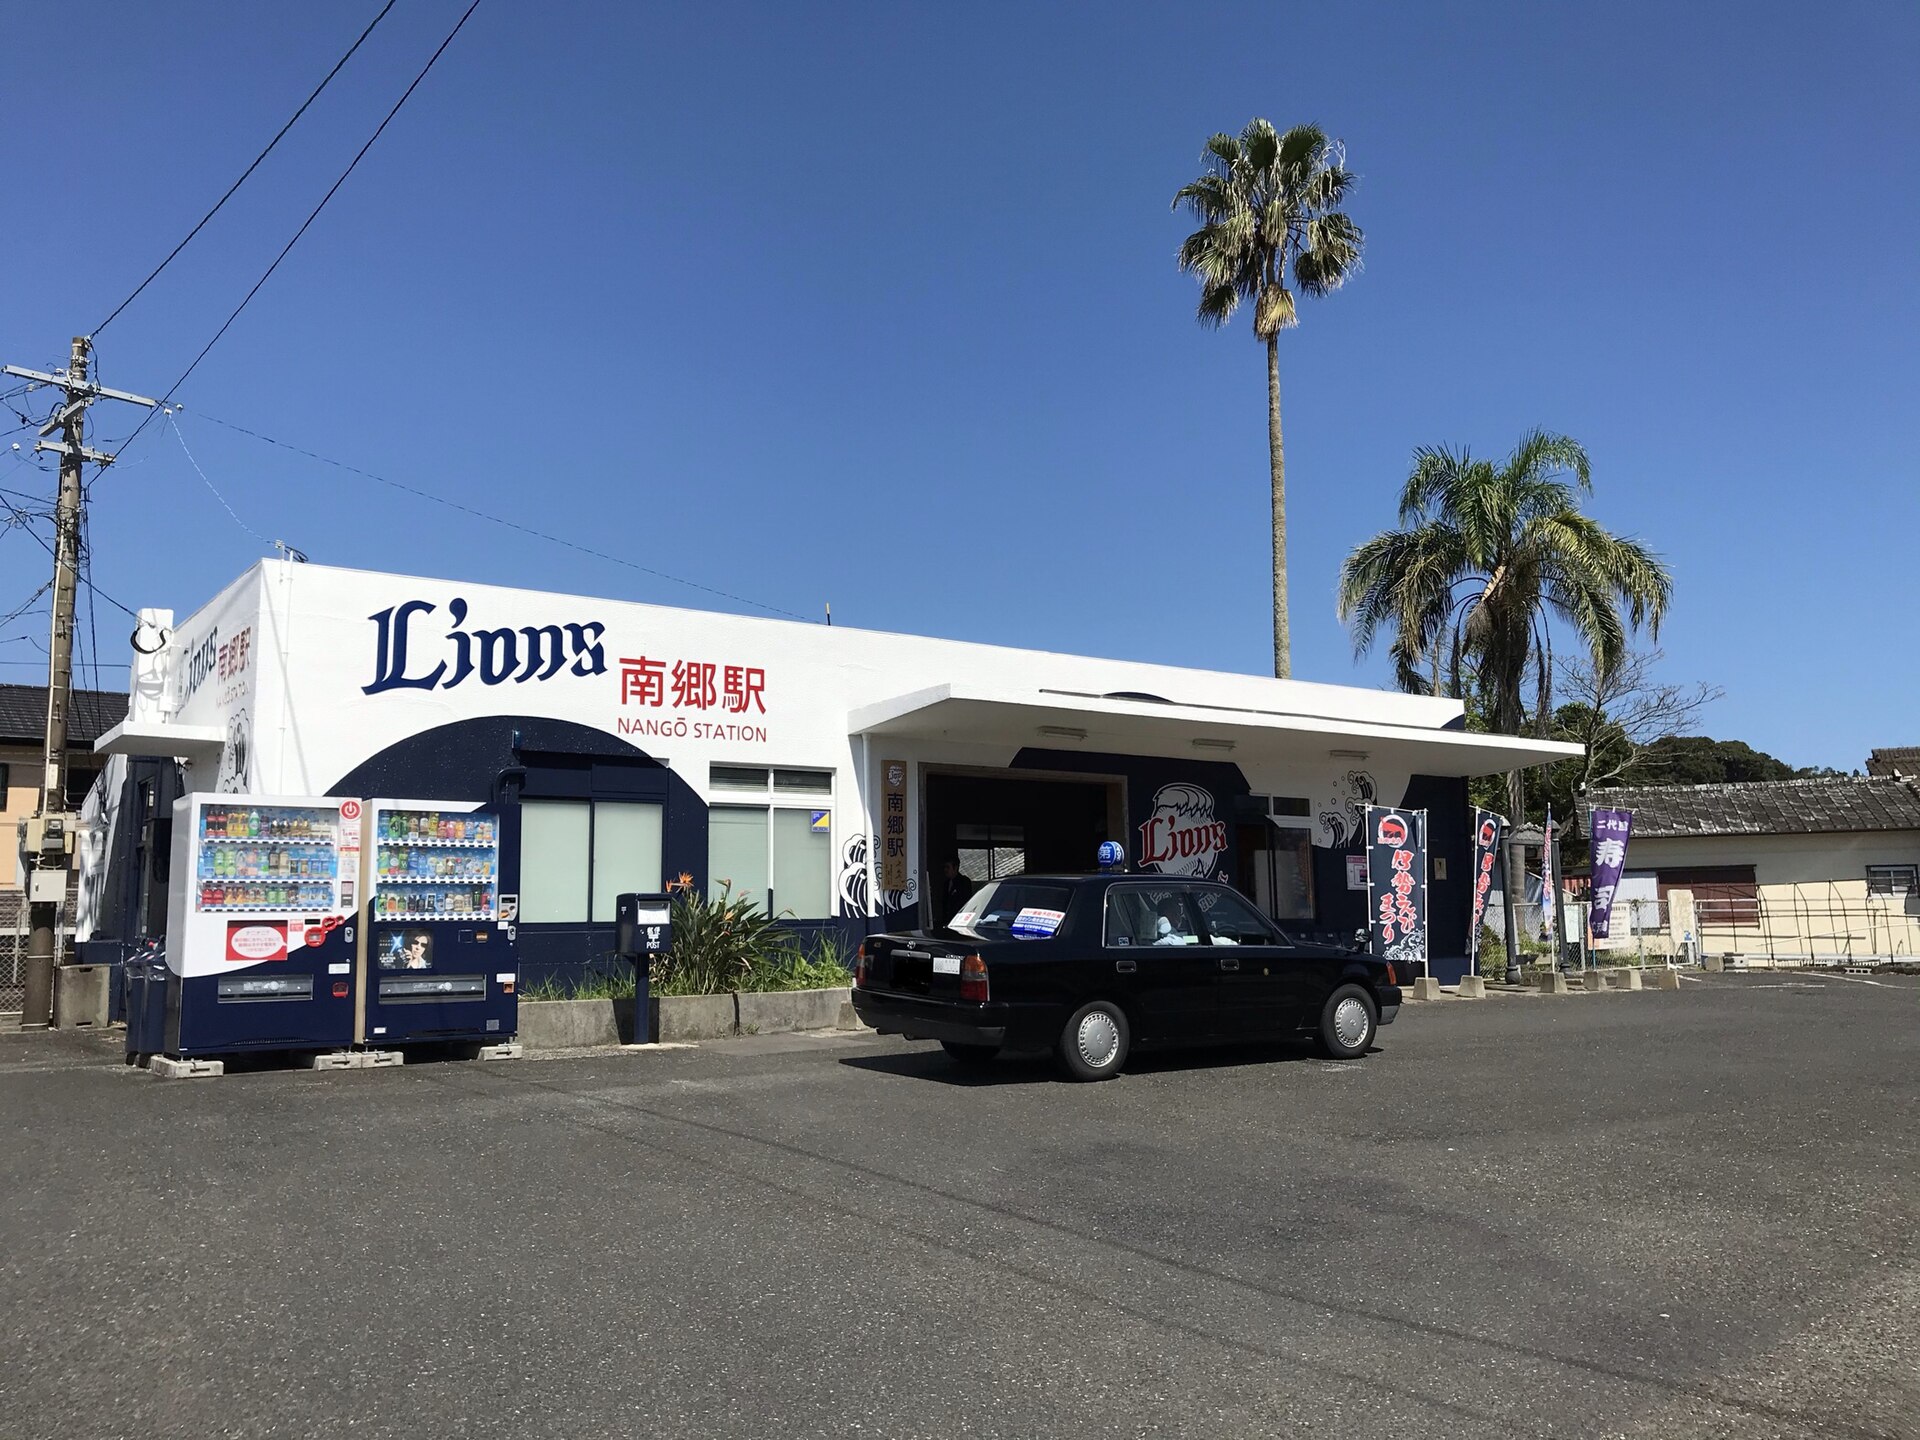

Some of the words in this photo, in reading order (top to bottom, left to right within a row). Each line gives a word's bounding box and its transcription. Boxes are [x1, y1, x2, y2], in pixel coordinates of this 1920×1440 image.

[619, 656, 767, 715] 南郷駅
[617, 717, 688, 737] NANGŌ
[694, 722, 767, 742] STATION
[887, 793, 904, 857] 南郷駅
[1379, 892, 1396, 944] まつり
[1391, 850, 1417, 934] 伊勢えび
[646, 941, 660, 949] POST
